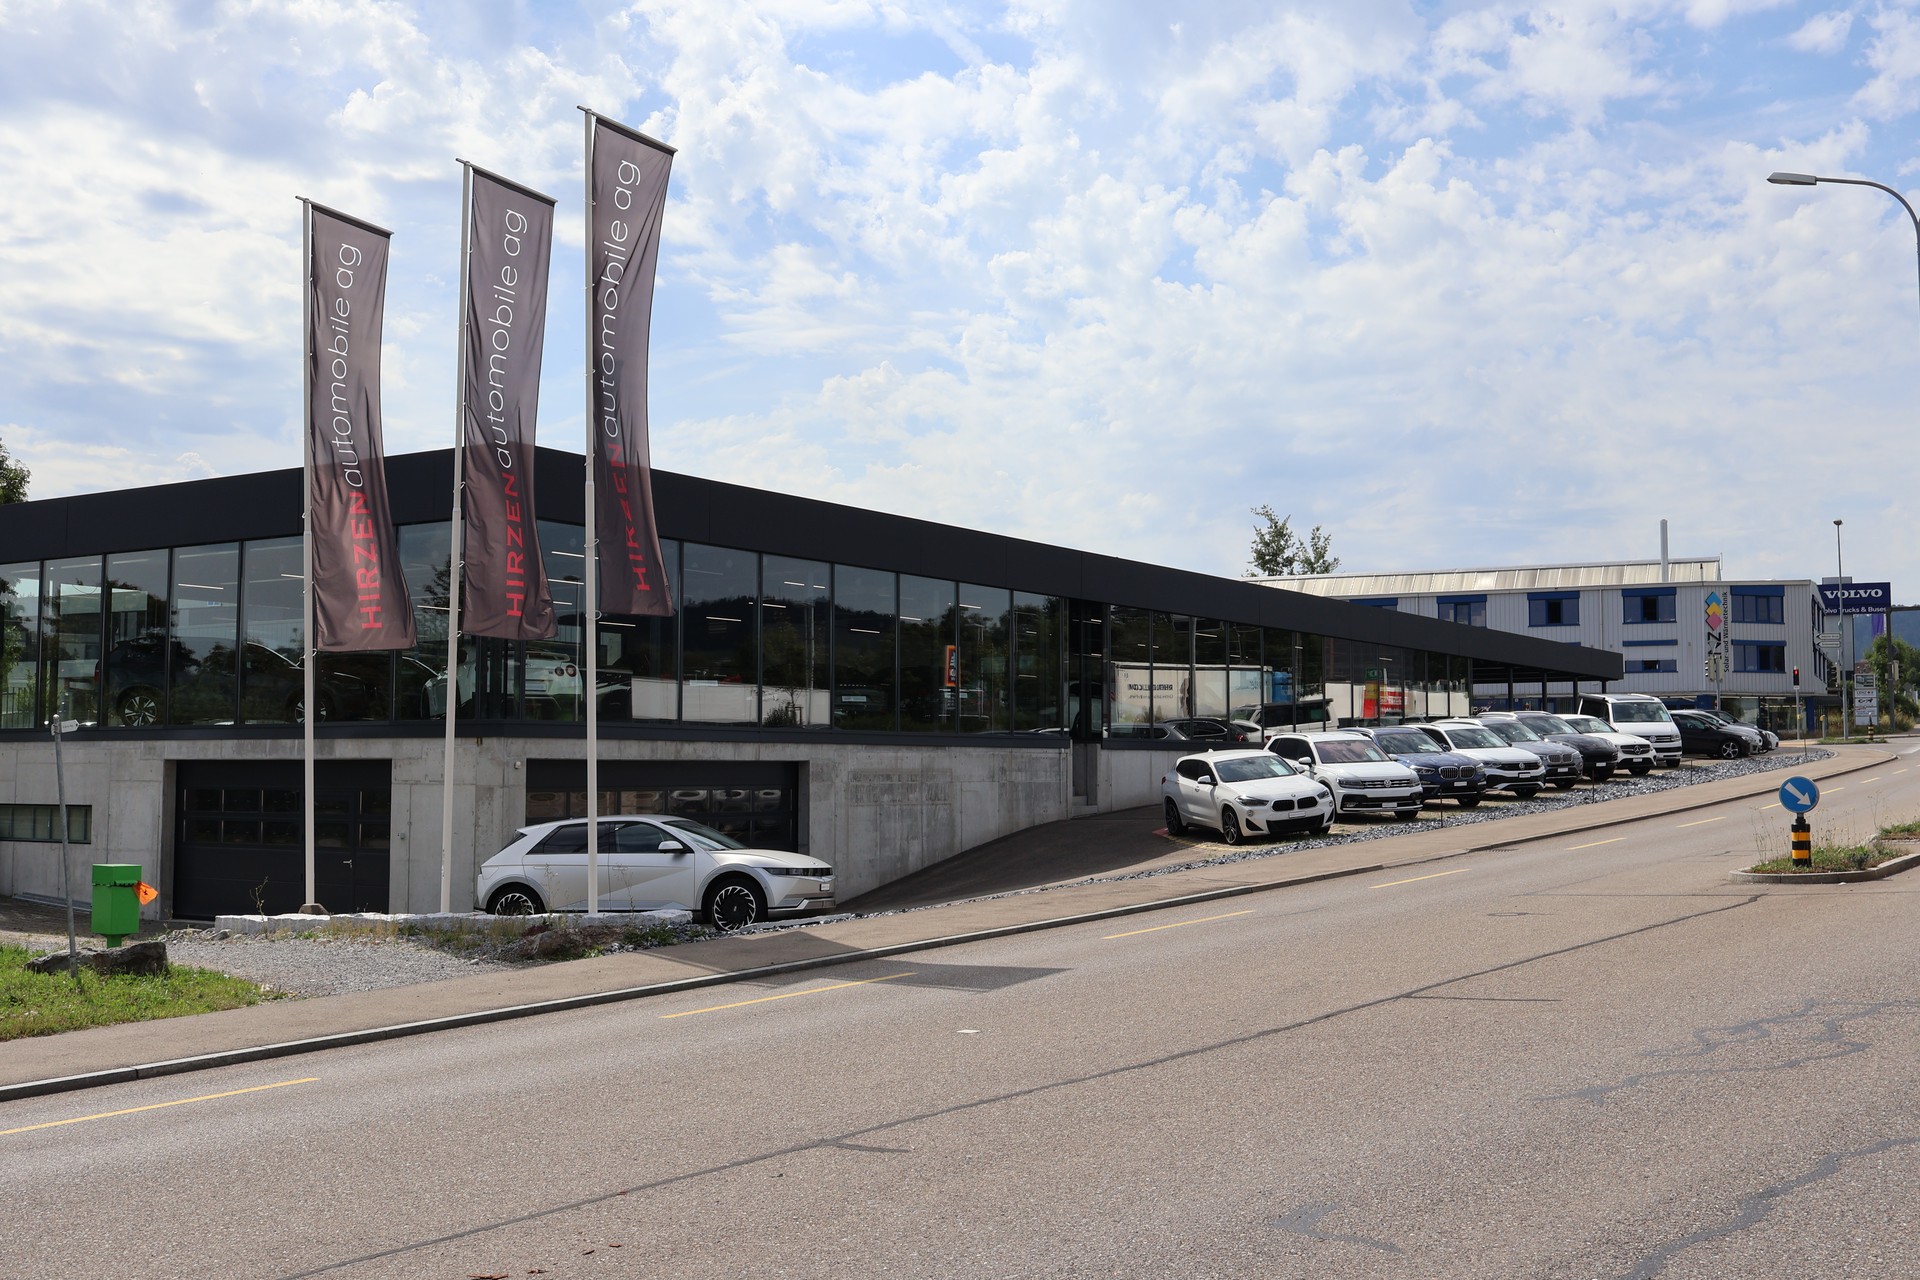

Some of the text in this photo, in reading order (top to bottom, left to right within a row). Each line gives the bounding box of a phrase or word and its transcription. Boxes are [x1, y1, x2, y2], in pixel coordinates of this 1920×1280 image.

[327, 243, 383, 629] HIRZEN automobile ag
[487, 208, 528, 617] HIRZEN automobile ag
[599, 159, 651, 591] HIRZEN automobile ag
[1721, 591, 1729, 640] Wärmetechnik
[1823, 589, 1883, 599] VOLVO
